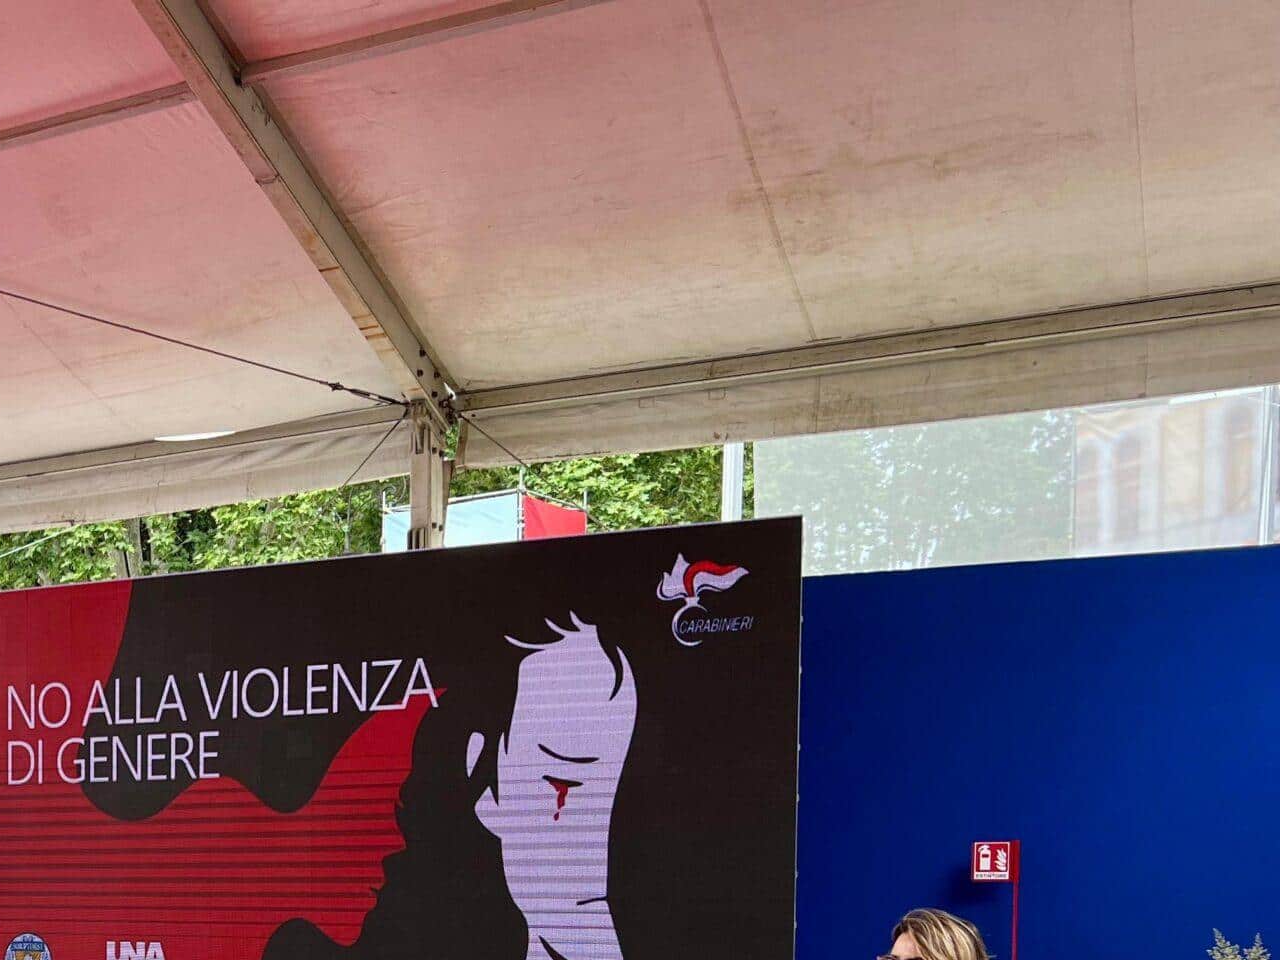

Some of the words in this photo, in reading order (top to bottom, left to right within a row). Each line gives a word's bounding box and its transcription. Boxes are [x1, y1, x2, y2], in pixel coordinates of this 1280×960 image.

[8, 682, 71, 730] NO
[82, 675, 188, 727] ALLA
[198, 657, 439, 720] VIOLENZA
[7, 740, 43, 785] DI
[56, 731, 220, 783] GENERE
